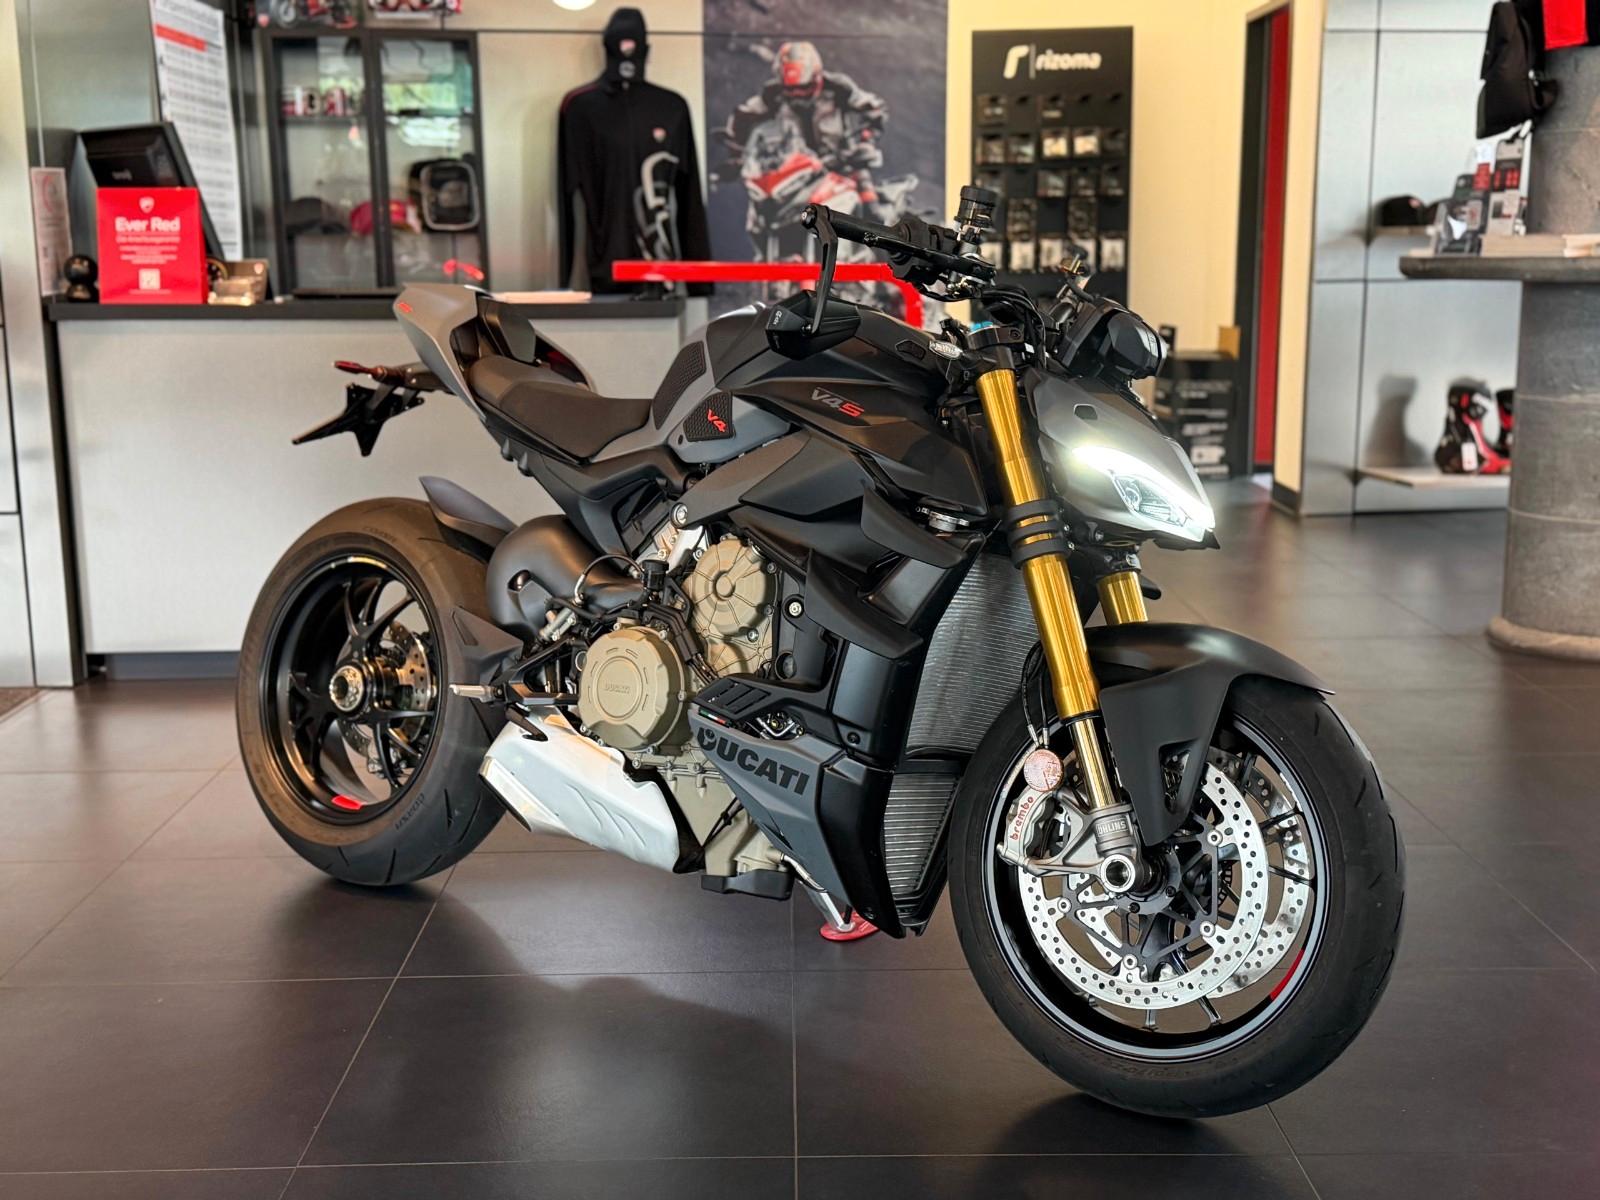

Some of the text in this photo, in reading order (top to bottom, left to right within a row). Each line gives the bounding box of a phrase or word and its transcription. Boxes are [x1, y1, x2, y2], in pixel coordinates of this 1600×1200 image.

[1035, 48, 1102, 71] rizoma
[115, 215, 181, 232] Ever Red
[811, 387, 865, 418] V4S
[706, 408, 727, 433] V4
[697, 727, 810, 796] DUCATI
[1009, 796, 1034, 841] brembo
